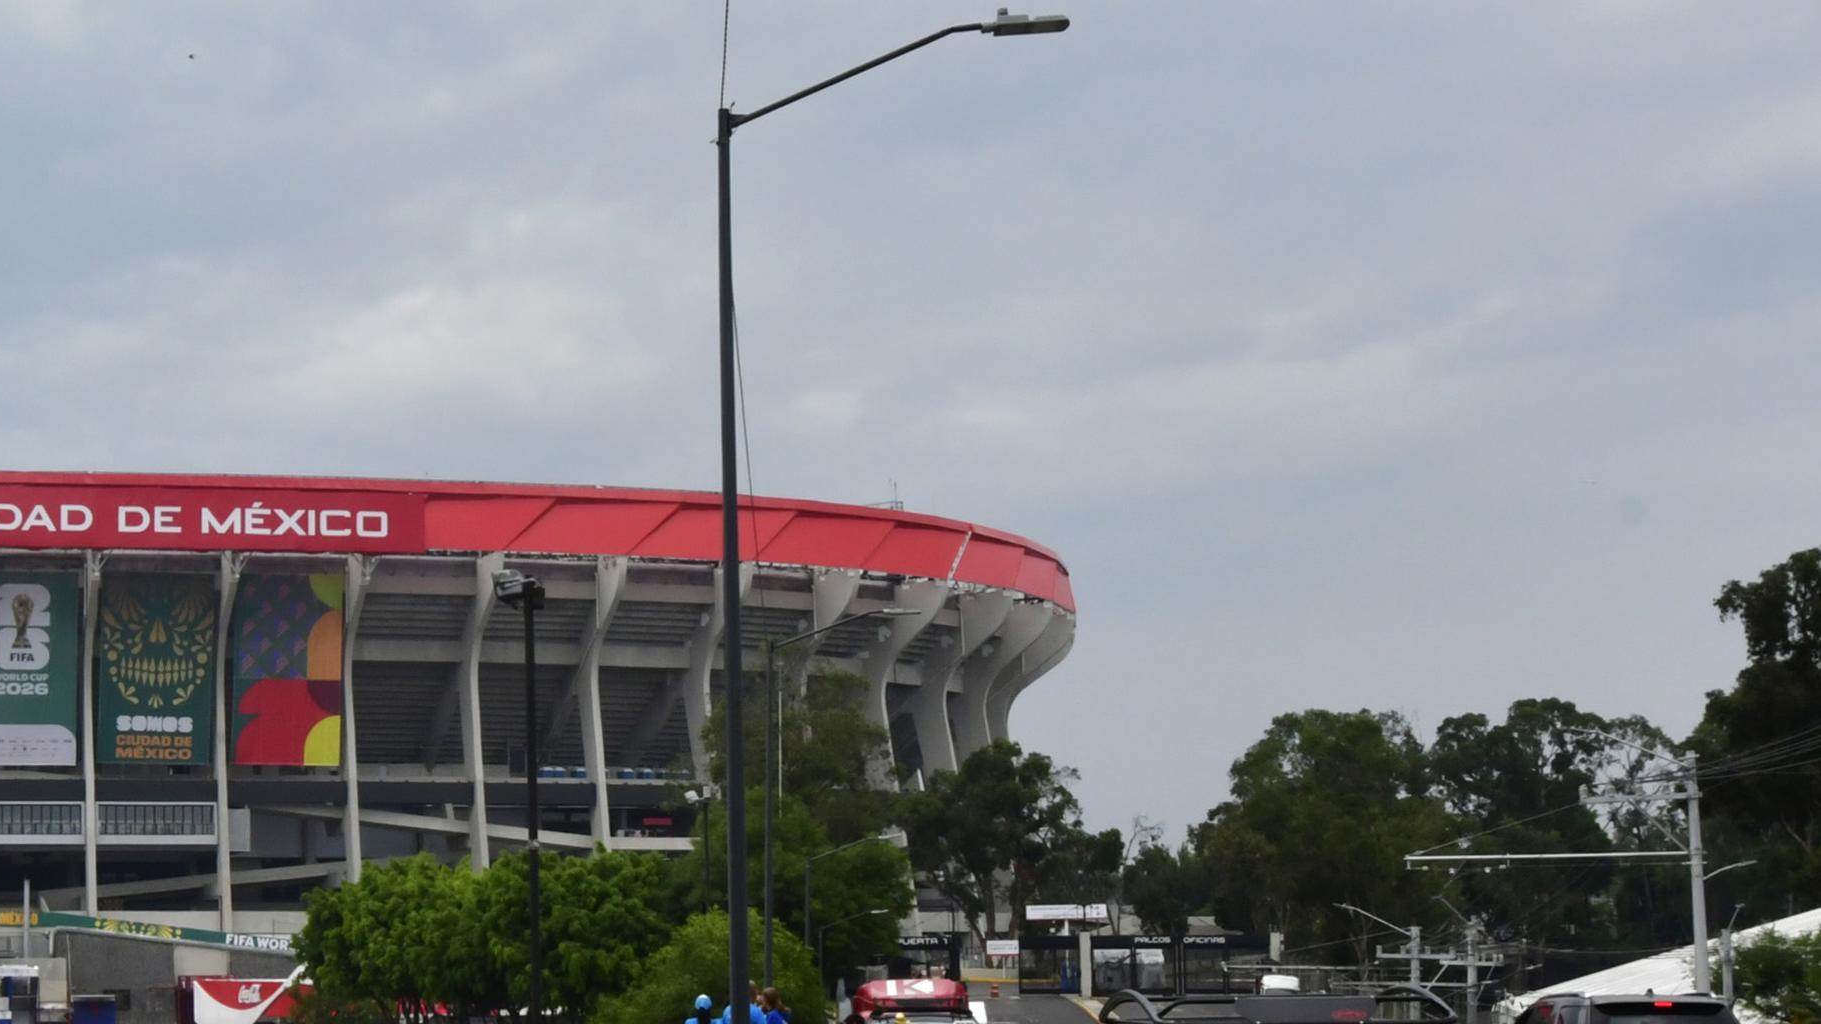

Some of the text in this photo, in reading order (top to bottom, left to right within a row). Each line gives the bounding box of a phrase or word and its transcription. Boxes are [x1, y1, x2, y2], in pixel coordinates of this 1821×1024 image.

[118, 506, 182, 533] DE
[201, 501, 389, 537] MÉXICO
[9, 653, 34, 662] FIFA
[29, 674, 50, 682] CUP
[116, 715, 193, 733] SOMOS
[116, 735, 193, 747] CIUDAD DE
[115, 747, 192, 760] MÉXICO
[226, 934, 292, 951] FIFA WOR
